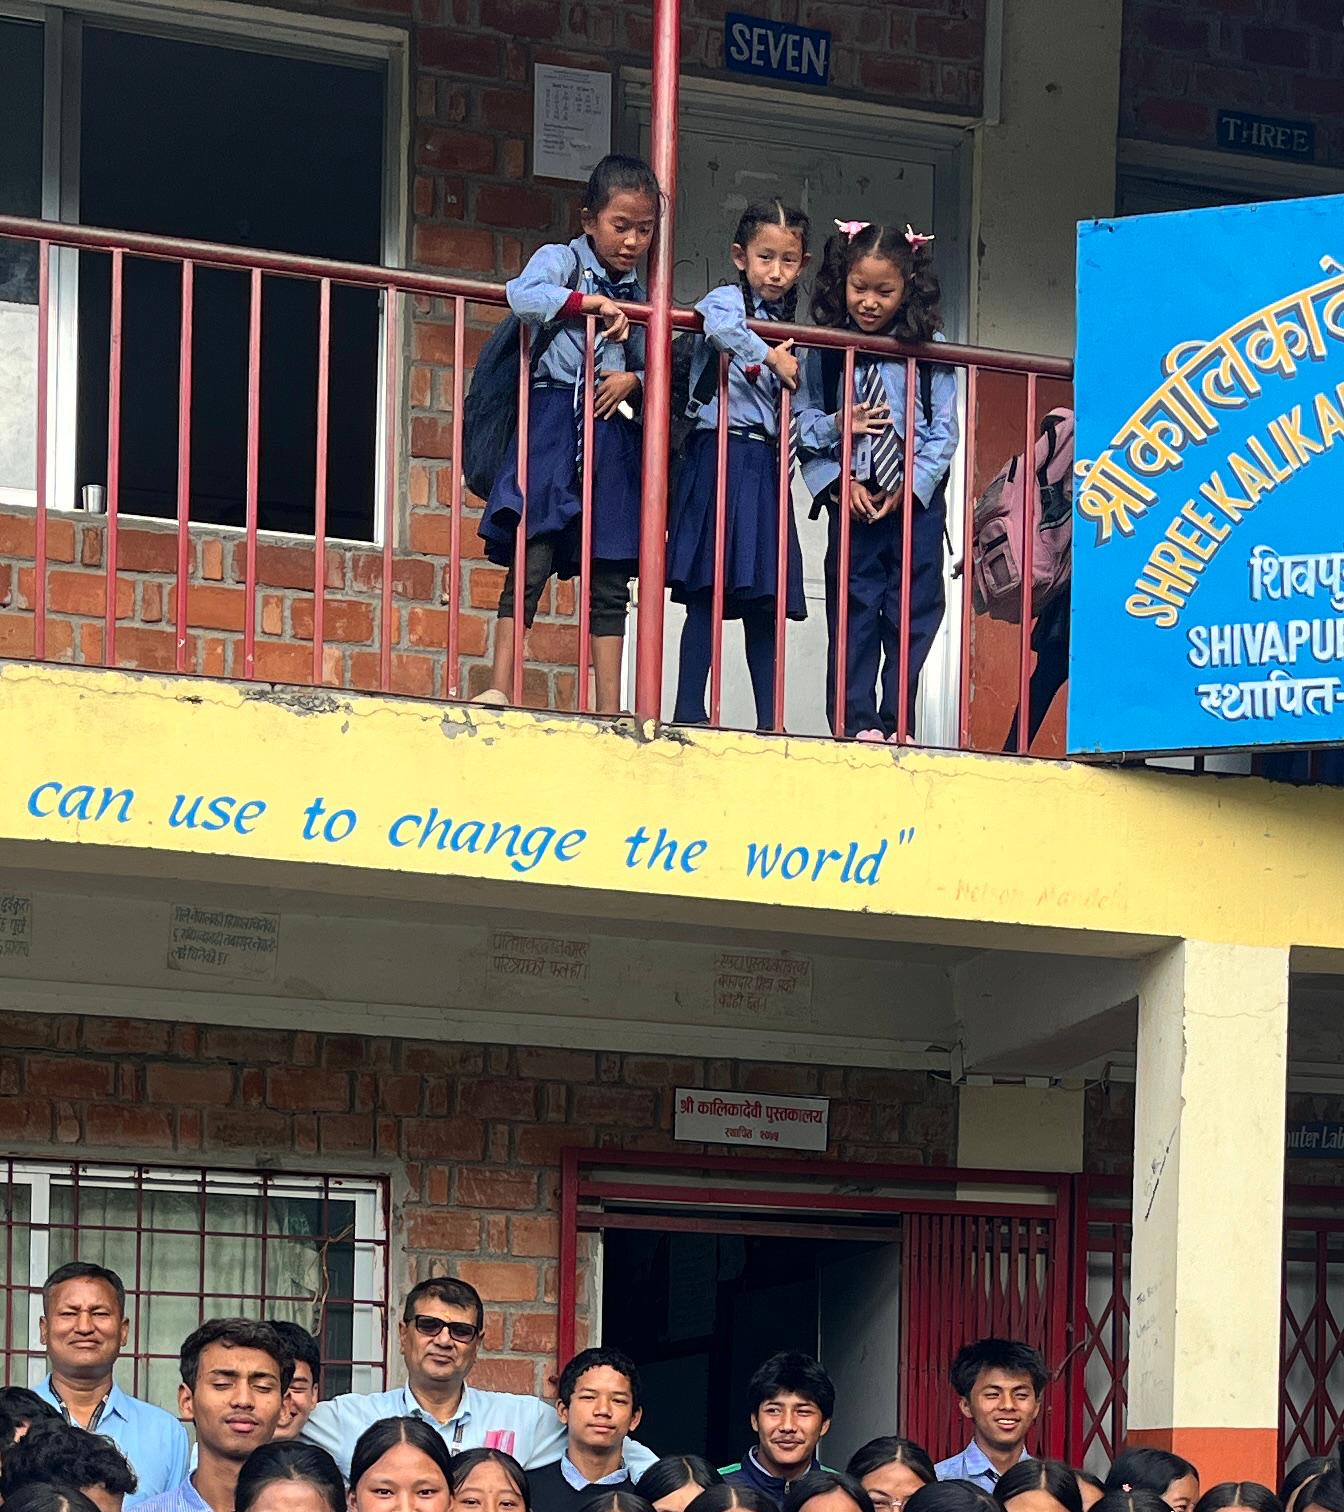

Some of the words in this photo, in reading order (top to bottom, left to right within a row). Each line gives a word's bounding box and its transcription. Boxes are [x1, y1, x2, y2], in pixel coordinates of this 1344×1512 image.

[730, 23, 826, 76] SEVEN
[1222, 117, 1309, 152] THREE
[1073, 450, 1157, 543] श्री
[1125, 499, 1233, 628] SHREE
[28, 780, 134, 823] can
[168, 792, 268, 835] use
[302, 796, 358, 842] to
[387, 807, 587, 872] change
[625, 825, 708, 874] the
